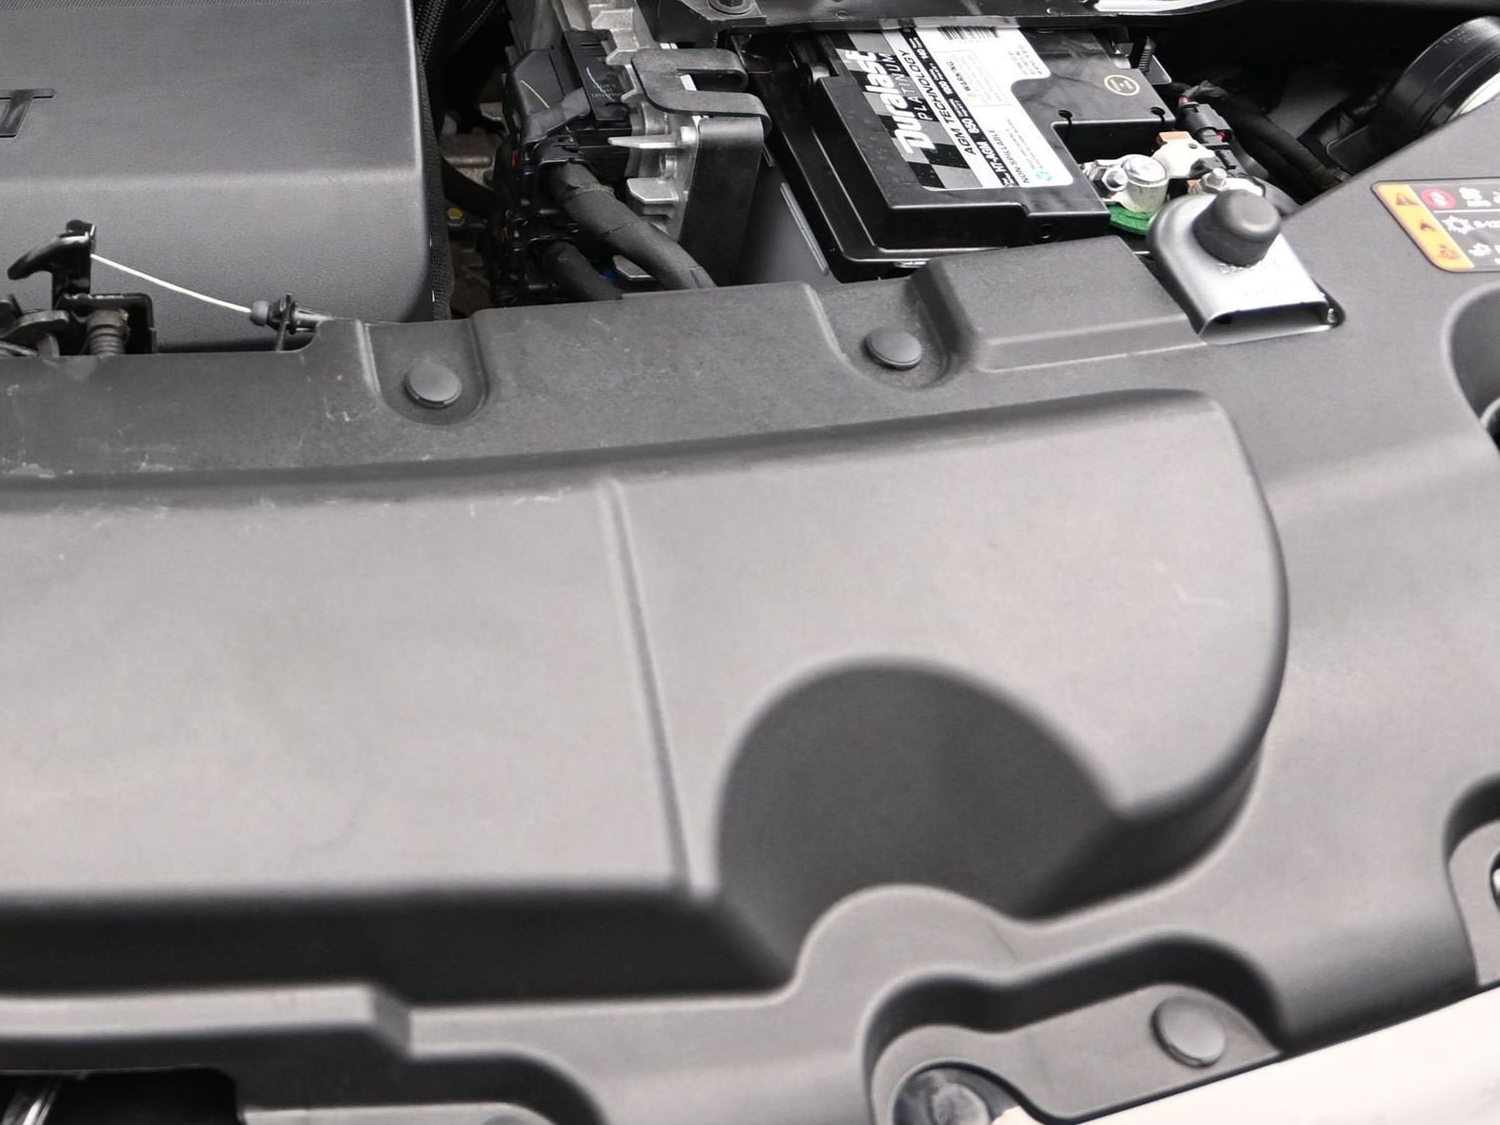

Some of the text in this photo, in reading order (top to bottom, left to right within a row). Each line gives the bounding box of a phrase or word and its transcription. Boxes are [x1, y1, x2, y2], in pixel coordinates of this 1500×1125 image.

[845, 50, 936, 154] Duralast
[878, 52, 934, 121] PLATINUM
[898, 49, 953, 124] TECHNOLOGY
[950, 127, 976, 155] AGM
[963, 118, 980, 134] 850
[977, 141, 1008, 174] H7-AGM
